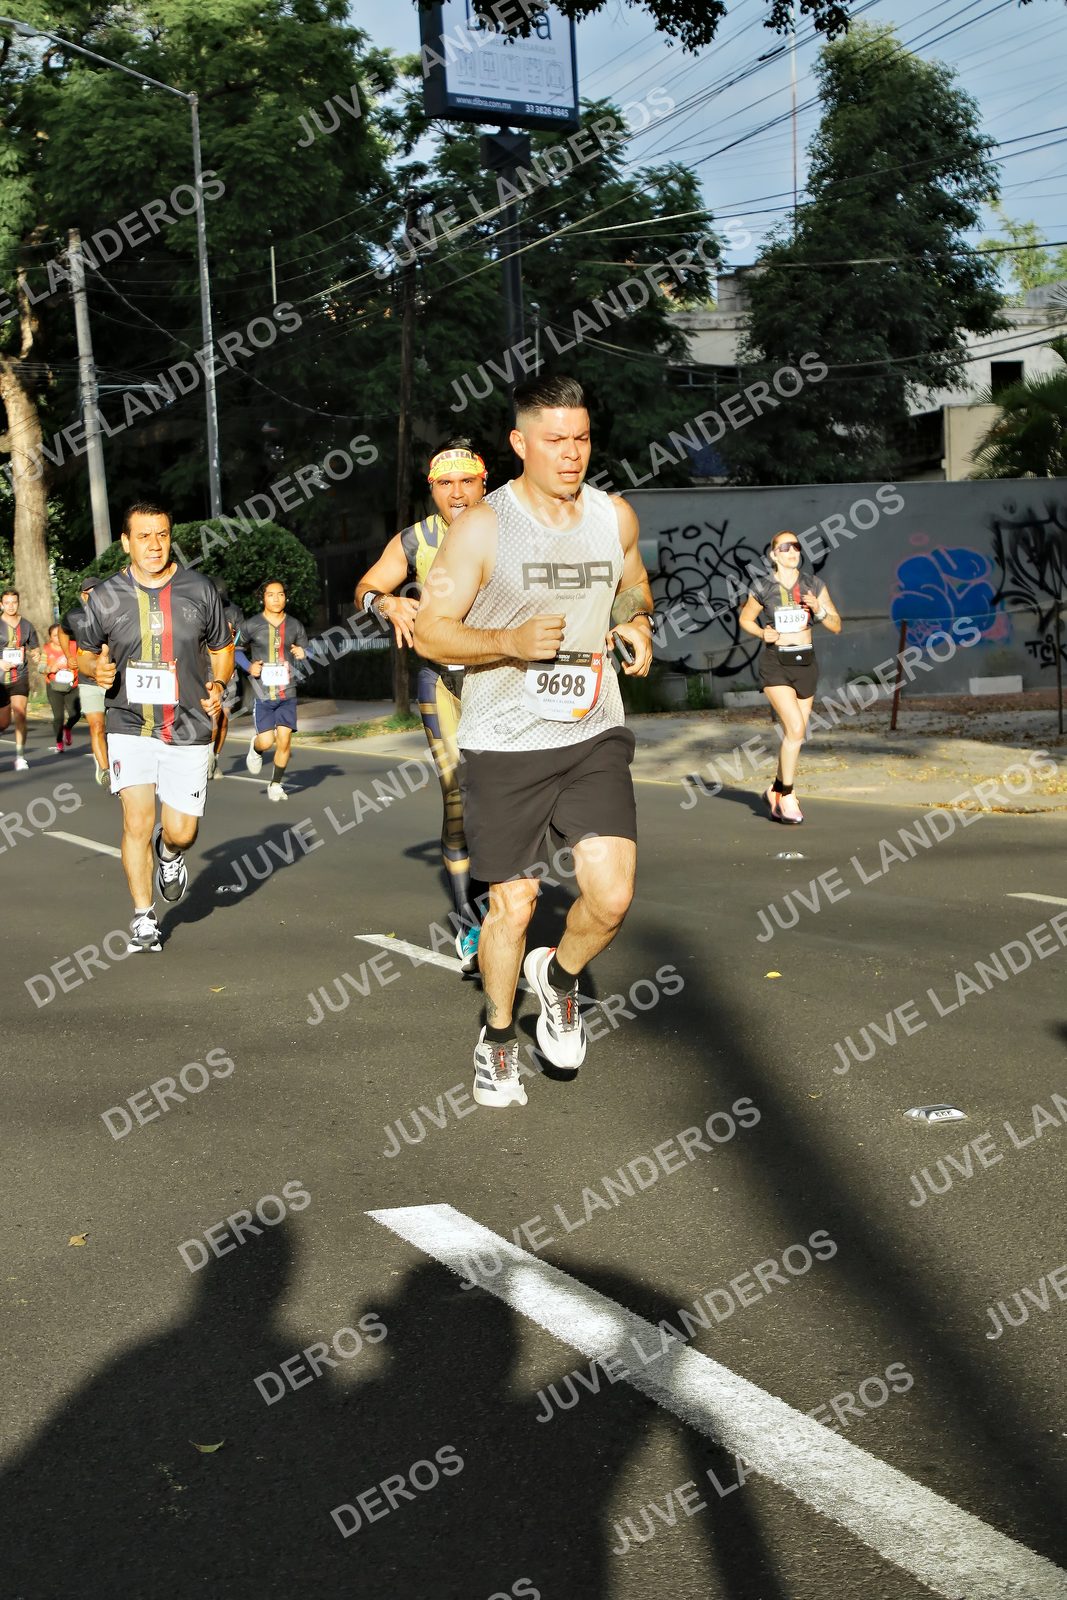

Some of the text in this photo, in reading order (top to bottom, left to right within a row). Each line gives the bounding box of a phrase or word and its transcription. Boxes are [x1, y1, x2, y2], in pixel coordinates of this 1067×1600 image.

[659, 520, 729, 547] TOY
[778, 612, 806, 623] 12389
[136, 675, 161, 689] 371
[537, 672, 586, 697] 9698
